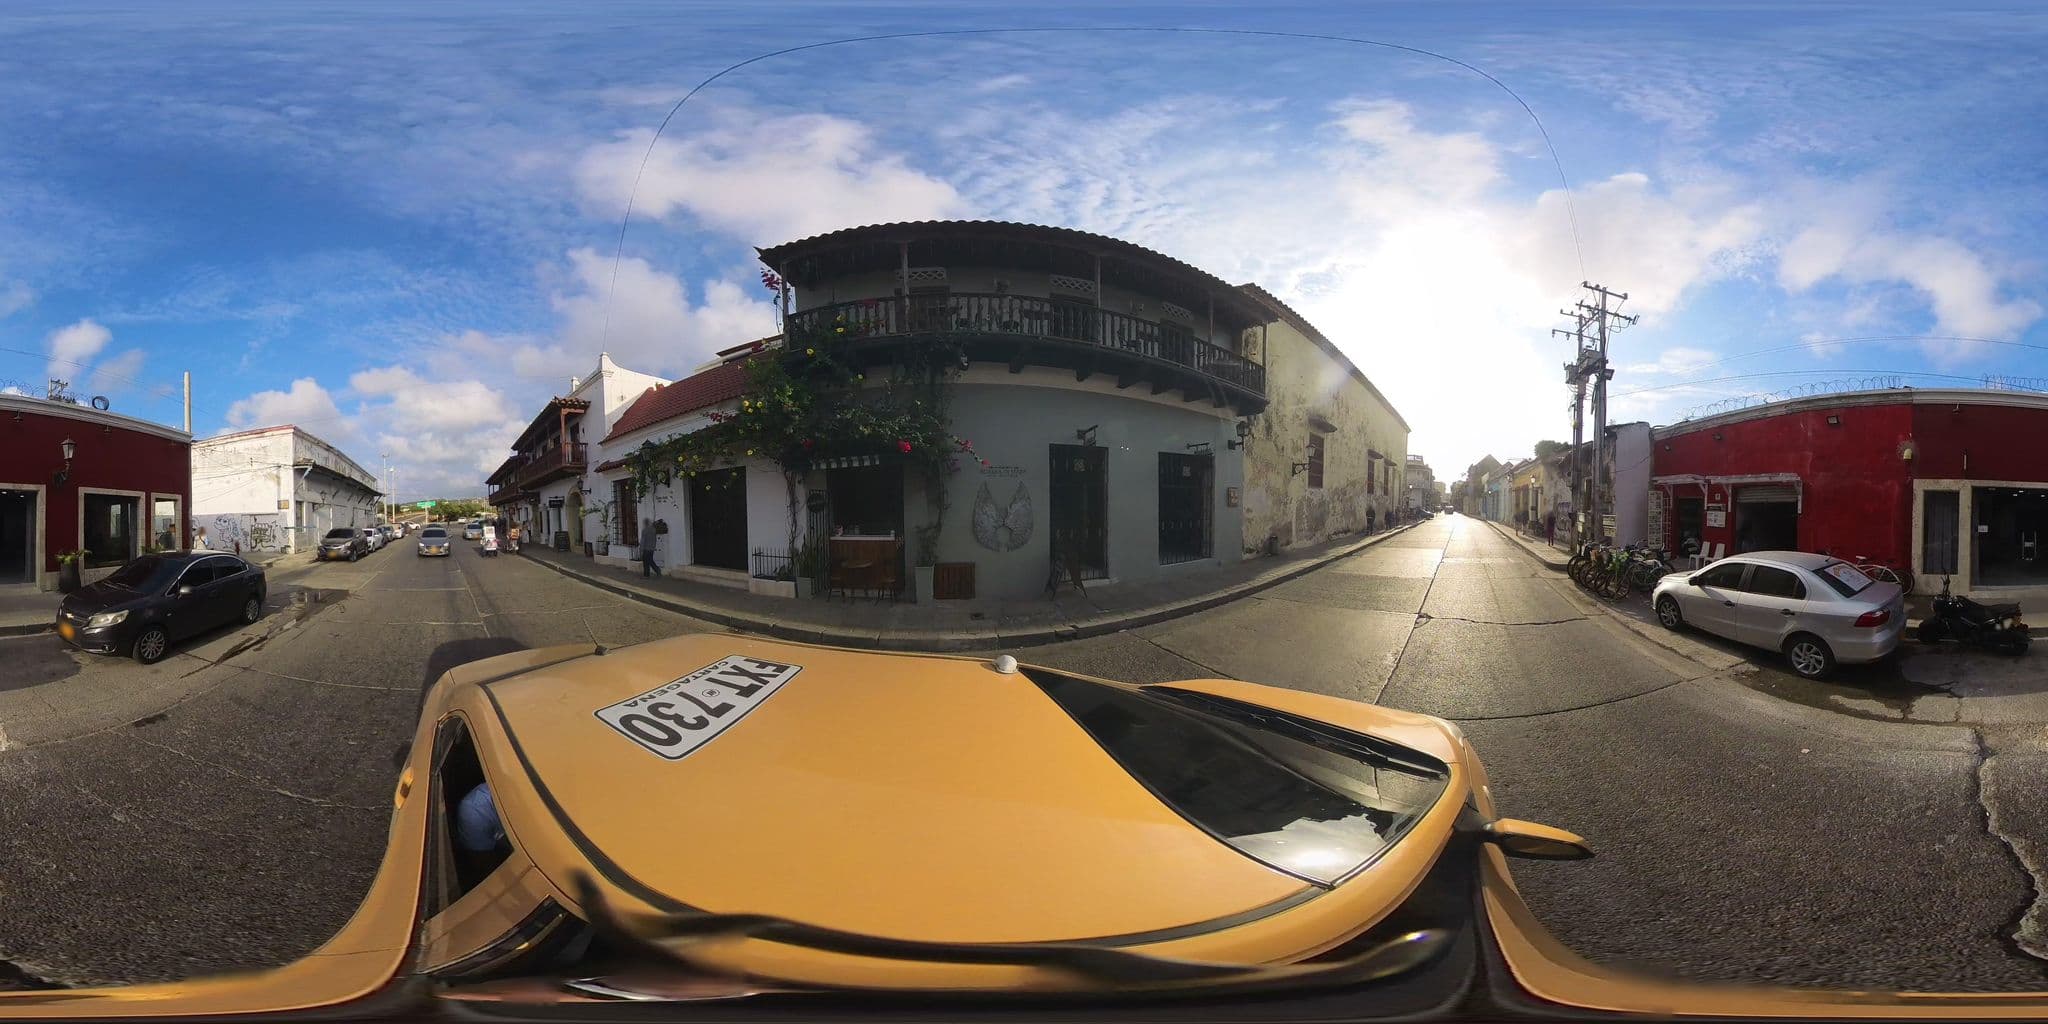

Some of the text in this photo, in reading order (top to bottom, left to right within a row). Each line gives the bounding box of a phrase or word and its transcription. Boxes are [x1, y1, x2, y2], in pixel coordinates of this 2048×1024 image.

[618, 658, 790, 747] FXT 730
[622, 661, 729, 707] CARTAGENA
